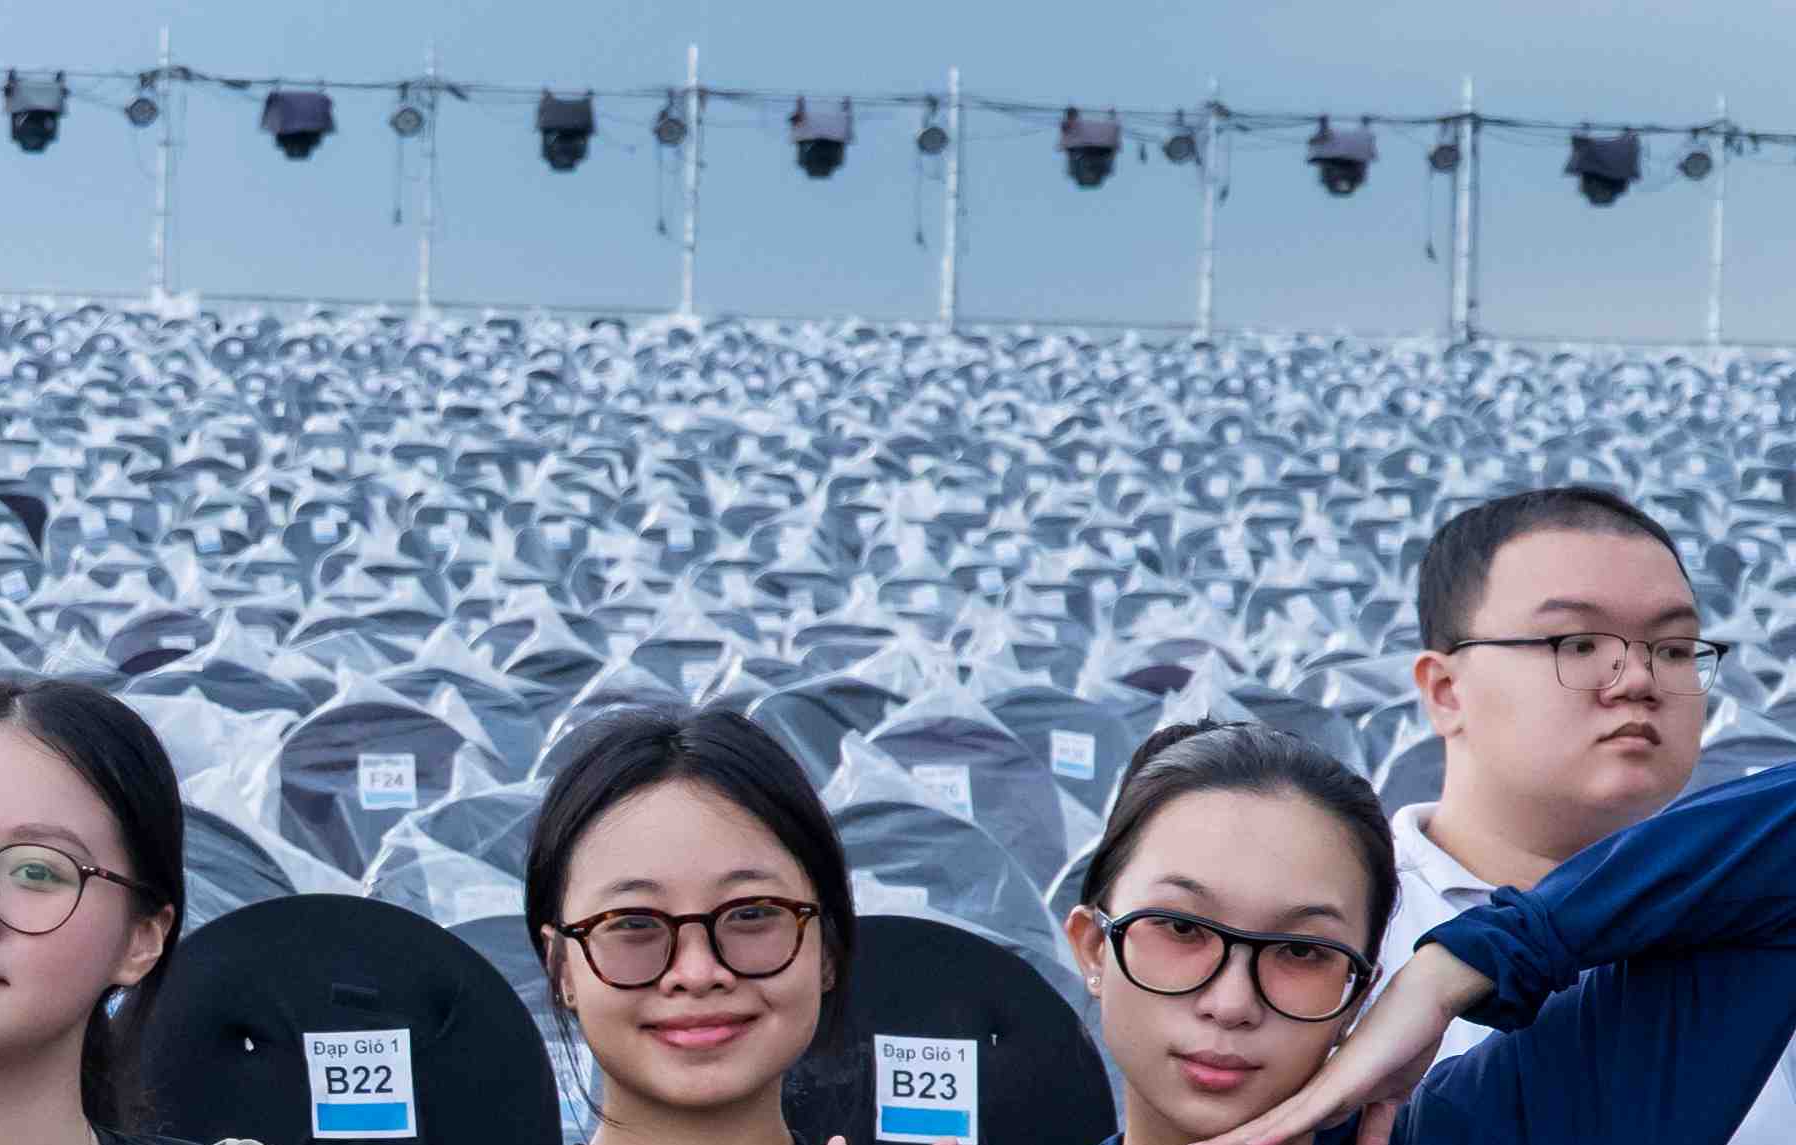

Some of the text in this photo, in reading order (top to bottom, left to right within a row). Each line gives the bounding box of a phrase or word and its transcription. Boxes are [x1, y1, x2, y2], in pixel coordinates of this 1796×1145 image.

[314, 1041, 348, 1059] Đạp
[391, 1038, 399, 1053] 1
[883, 1043, 916, 1062] Đạp
[957, 1048, 965, 1062] 1
[324, 1065, 393, 1094] B22
[892, 1070, 957, 1101] B23
